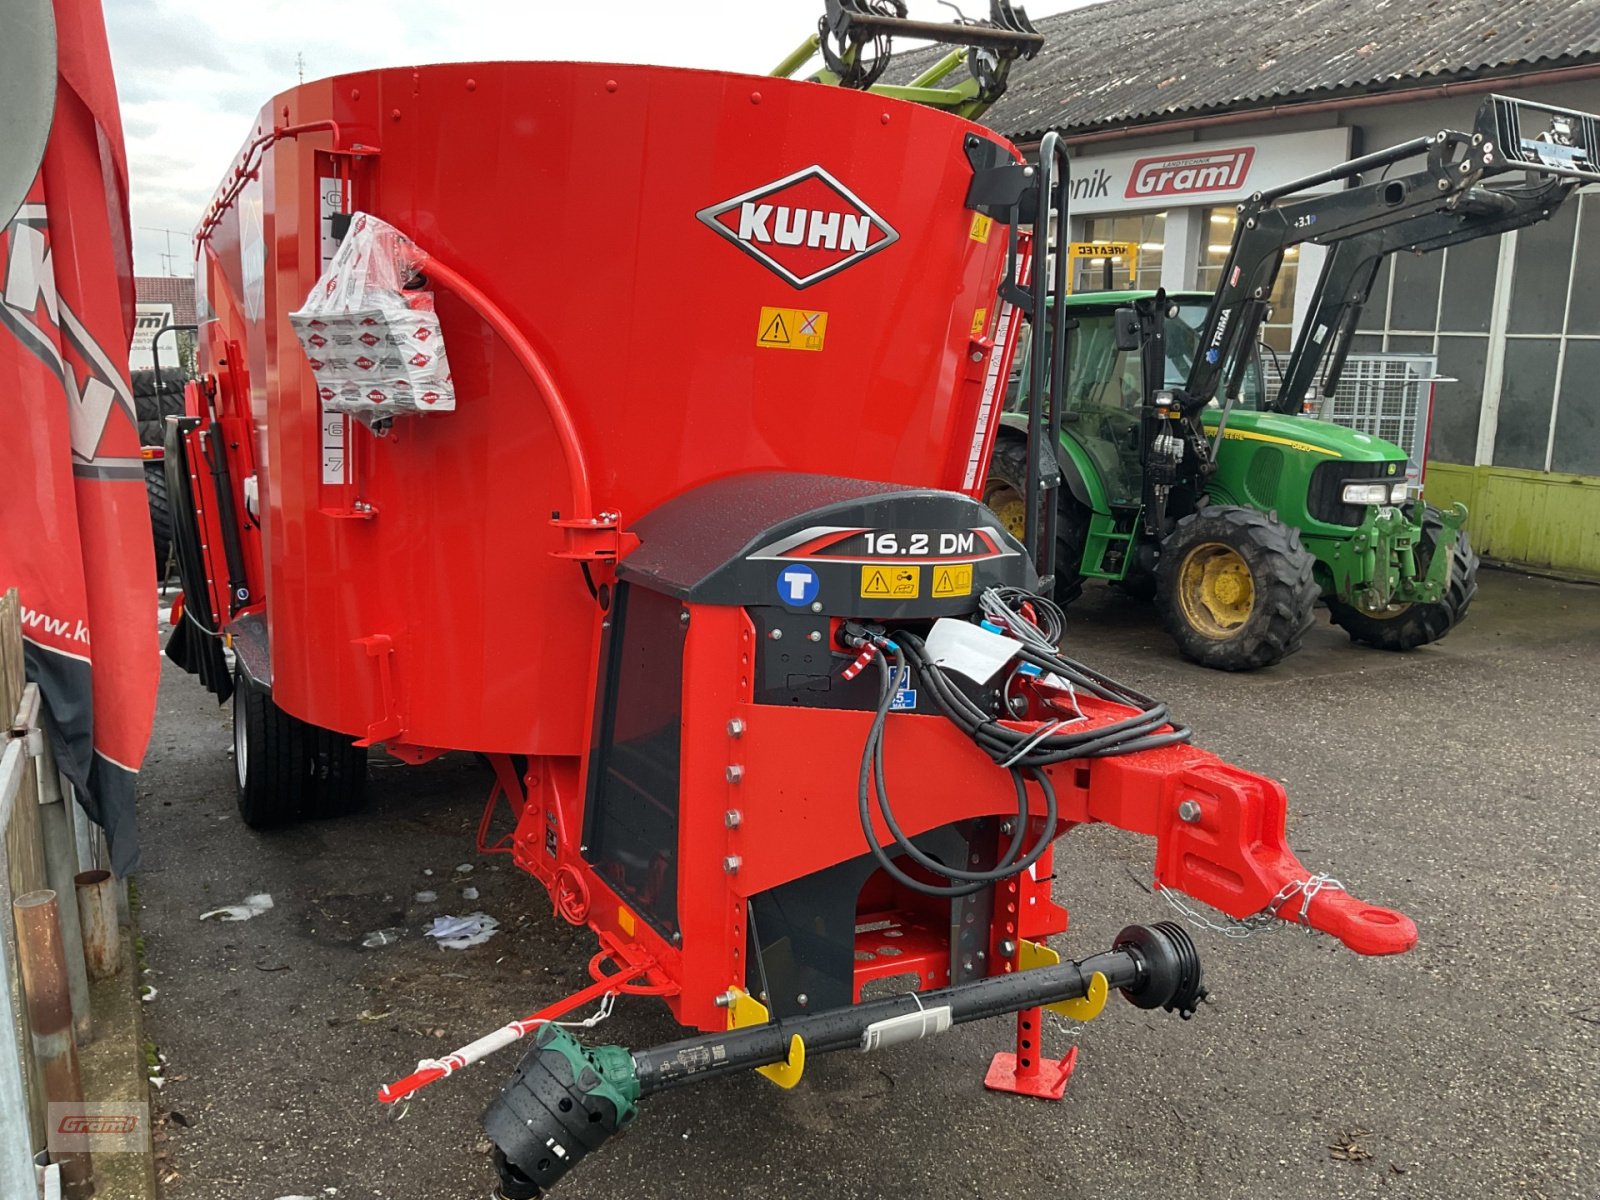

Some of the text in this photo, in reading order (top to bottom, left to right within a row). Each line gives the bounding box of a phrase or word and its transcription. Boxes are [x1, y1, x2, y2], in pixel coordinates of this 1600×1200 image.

[1135, 152, 1246, 195] Graml
[738, 201, 870, 252] KUHN
[1210, 308, 1232, 347] TRIMA
[327, 422, 343, 437] 6
[328, 457, 344, 472] 7
[864, 532, 974, 555] 16.2 DM
[784, 572, 812, 600] T
